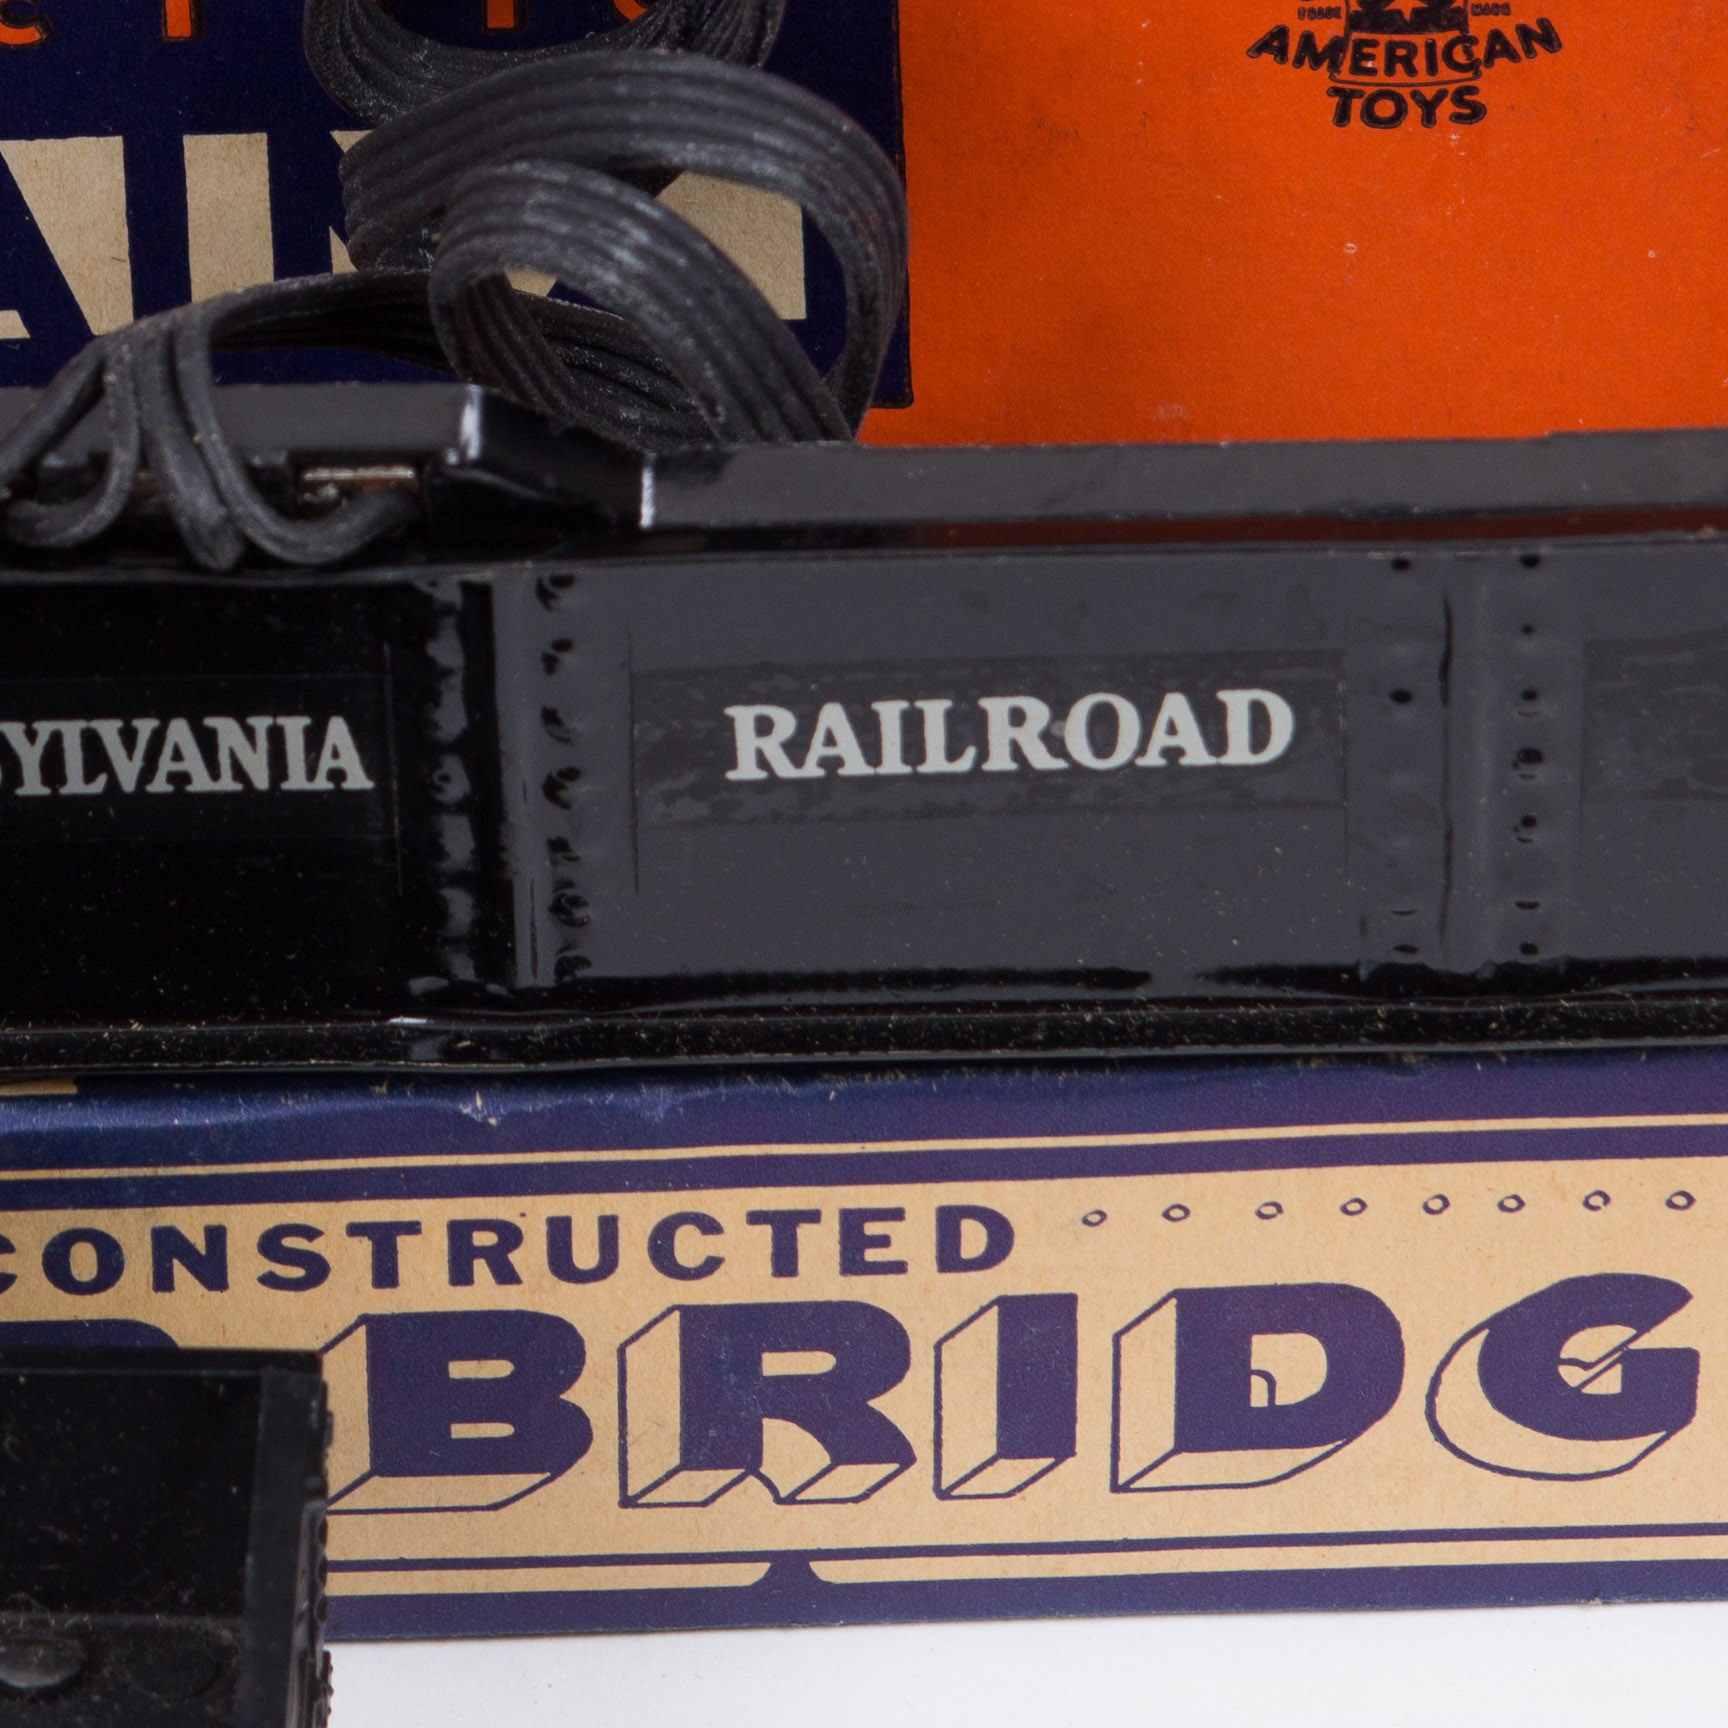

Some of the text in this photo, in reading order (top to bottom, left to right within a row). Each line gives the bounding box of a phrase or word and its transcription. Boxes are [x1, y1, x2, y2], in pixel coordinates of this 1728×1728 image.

[1246, 17, 1562, 77] AMERICAN
[1326, 85, 1487, 129] TOYS
[724, 688, 1295, 781] RAILROAD
[322, 1273, 1702, 1513] BRIDG
